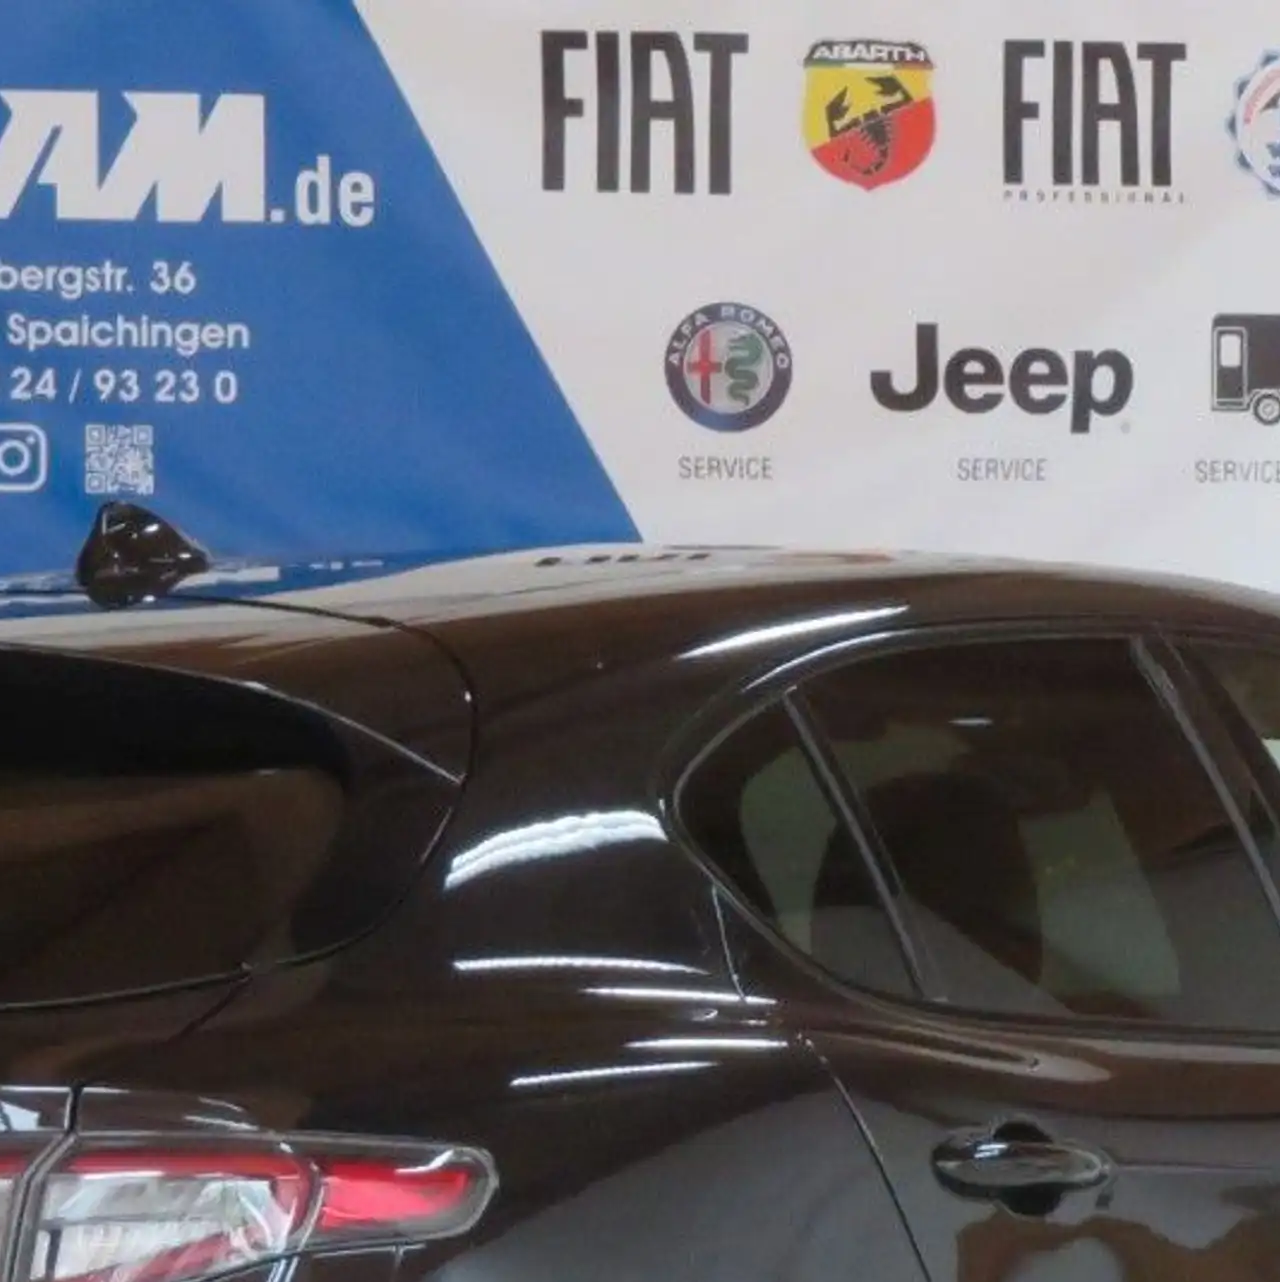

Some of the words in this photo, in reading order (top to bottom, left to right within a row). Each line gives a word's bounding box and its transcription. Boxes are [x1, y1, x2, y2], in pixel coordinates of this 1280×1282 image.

[813, 43, 925, 61] ABARTH
[541, 30, 749, 195] FIAT
[1004, 40, 1186, 186] FIAT
[150, 261, 197, 294] 36
[7, 311, 250, 356] Spaichingen
[669, 313, 708, 366] ALFA
[721, 305, 789, 369] ROMEO
[10, 367, 57, 400] 24
[68, 369, 82, 403] /
[94, 369, 140, 402] 93
[154, 370, 199, 403] 23
[215, 371, 238, 403] 0
[870, 323, 1133, 434] Jeep
[678, 455, 773, 480] SERVICE
[957, 457, 1048, 481] SERVICE
